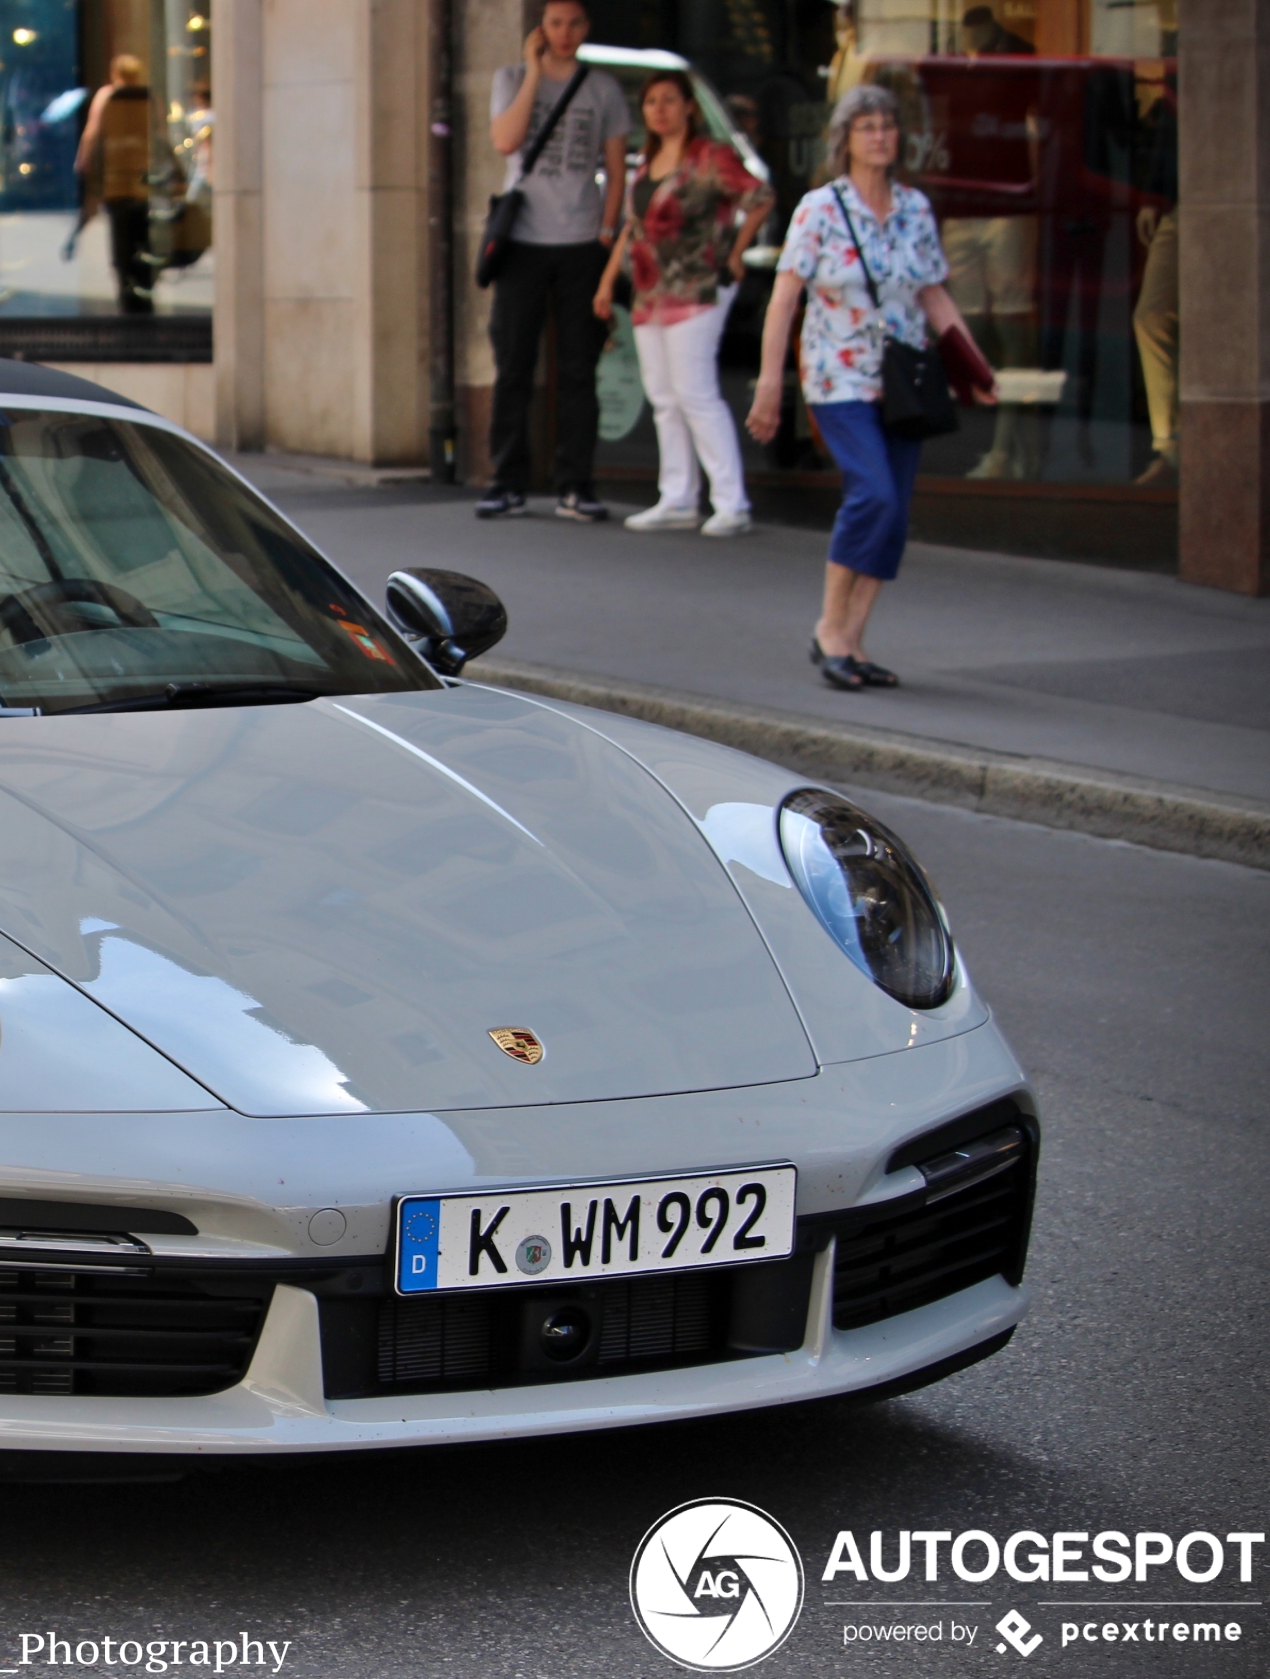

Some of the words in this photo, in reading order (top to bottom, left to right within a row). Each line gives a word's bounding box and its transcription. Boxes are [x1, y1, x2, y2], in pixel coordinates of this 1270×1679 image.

[469, 1206, 511, 1276] K
[560, 1195, 641, 1268] WM
[656, 1182, 767, 1258] 992
[412, 1255, 426, 1274] D
